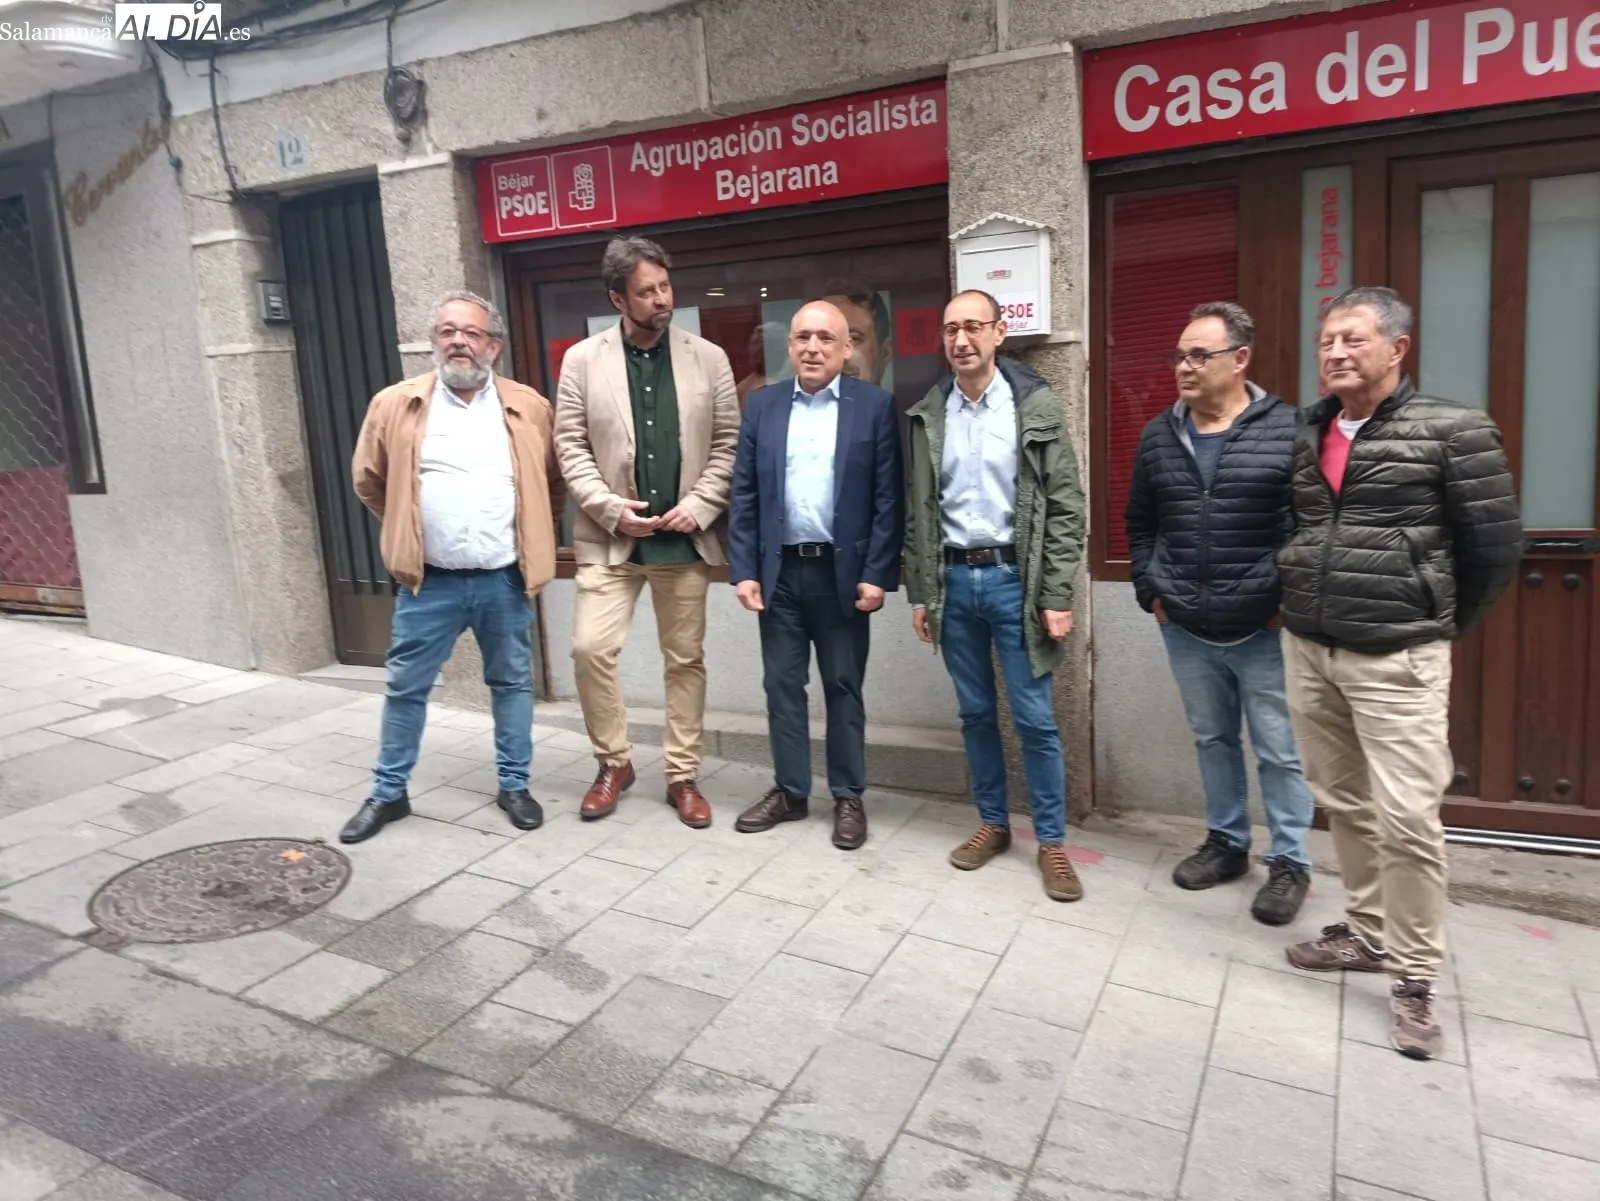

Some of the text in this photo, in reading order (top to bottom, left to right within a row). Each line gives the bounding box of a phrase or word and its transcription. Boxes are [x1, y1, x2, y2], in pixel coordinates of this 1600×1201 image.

[1113, 64, 1288, 133] Casa
[1315, 19, 1430, 105] del
[279, 137, 304, 168] 12
[629, 95, 938, 177] Agrupación Socialista
[497, 172, 536, 192] Béjar
[715, 160, 839, 204] Bejarana
[500, 191, 550, 219] PSOE
[1314, 187, 1345, 288] bejarana
[1000, 302, 1034, 319] PSOE
